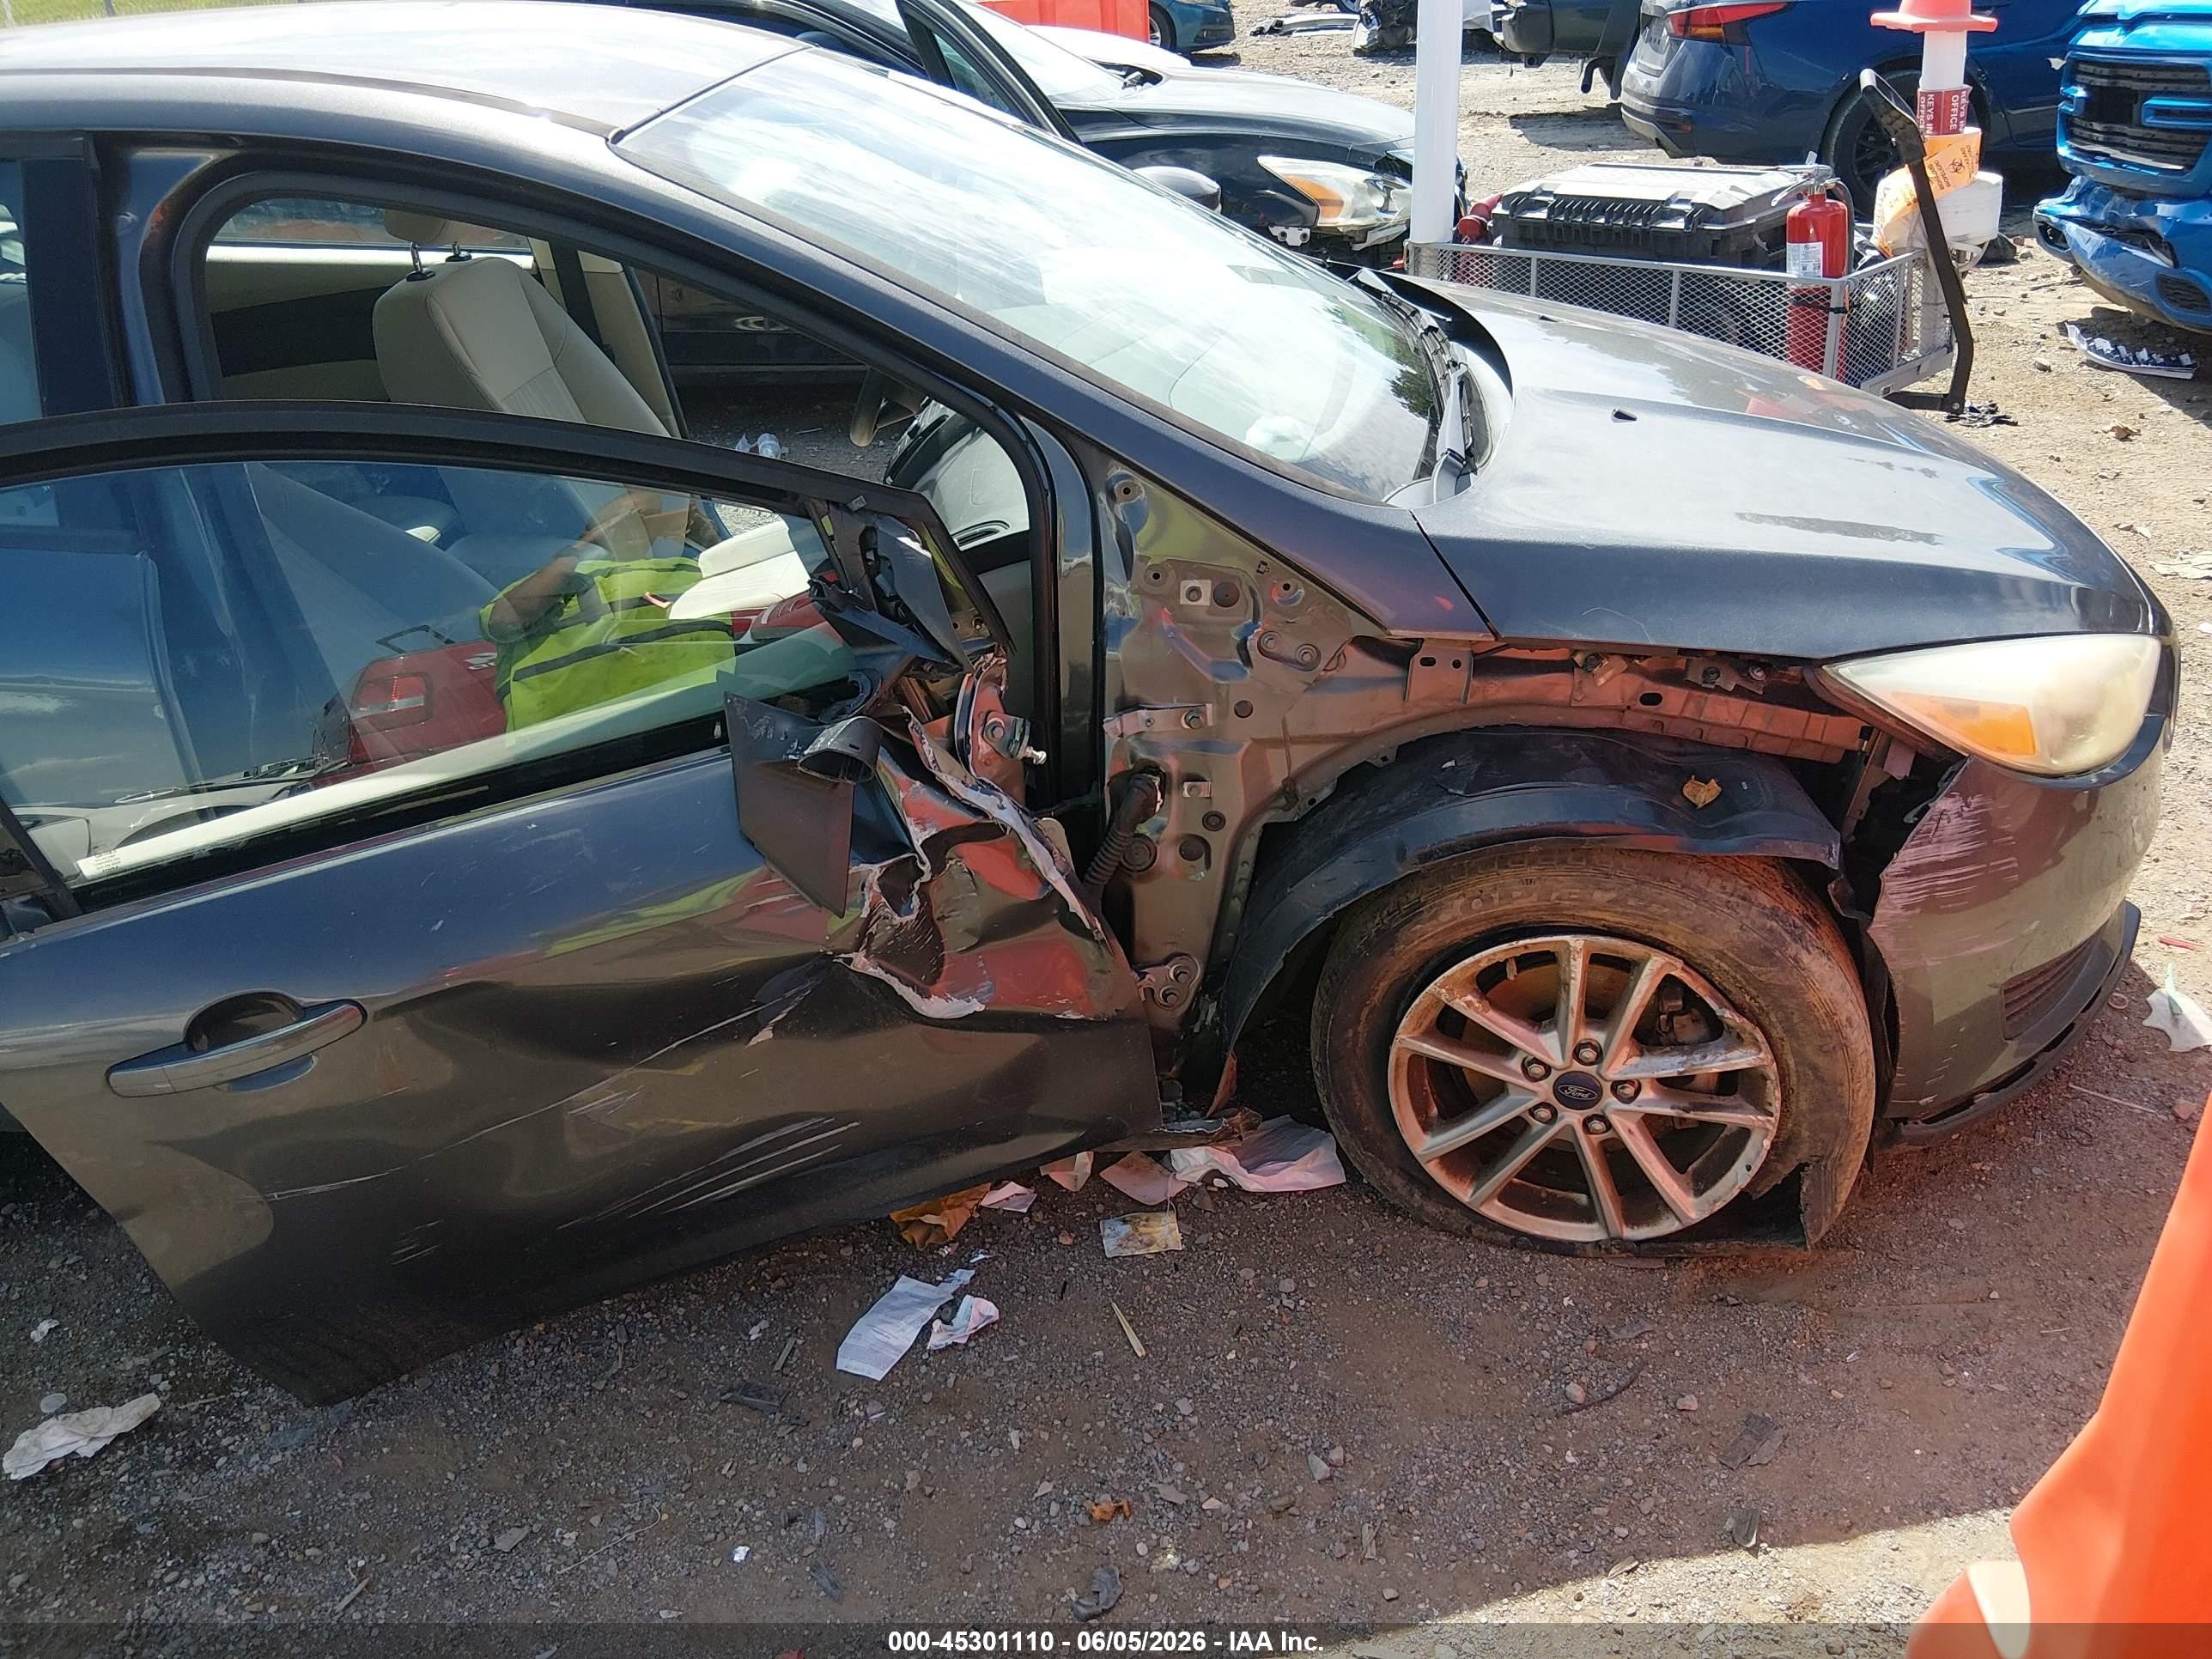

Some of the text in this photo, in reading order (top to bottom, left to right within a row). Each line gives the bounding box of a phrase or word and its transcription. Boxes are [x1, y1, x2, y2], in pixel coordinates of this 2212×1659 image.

[1925, 94, 1935, 134] KEYS IN
[1950, 94, 1959, 131] OFFICE
[1565, 1086, 1591, 1098] Ford
